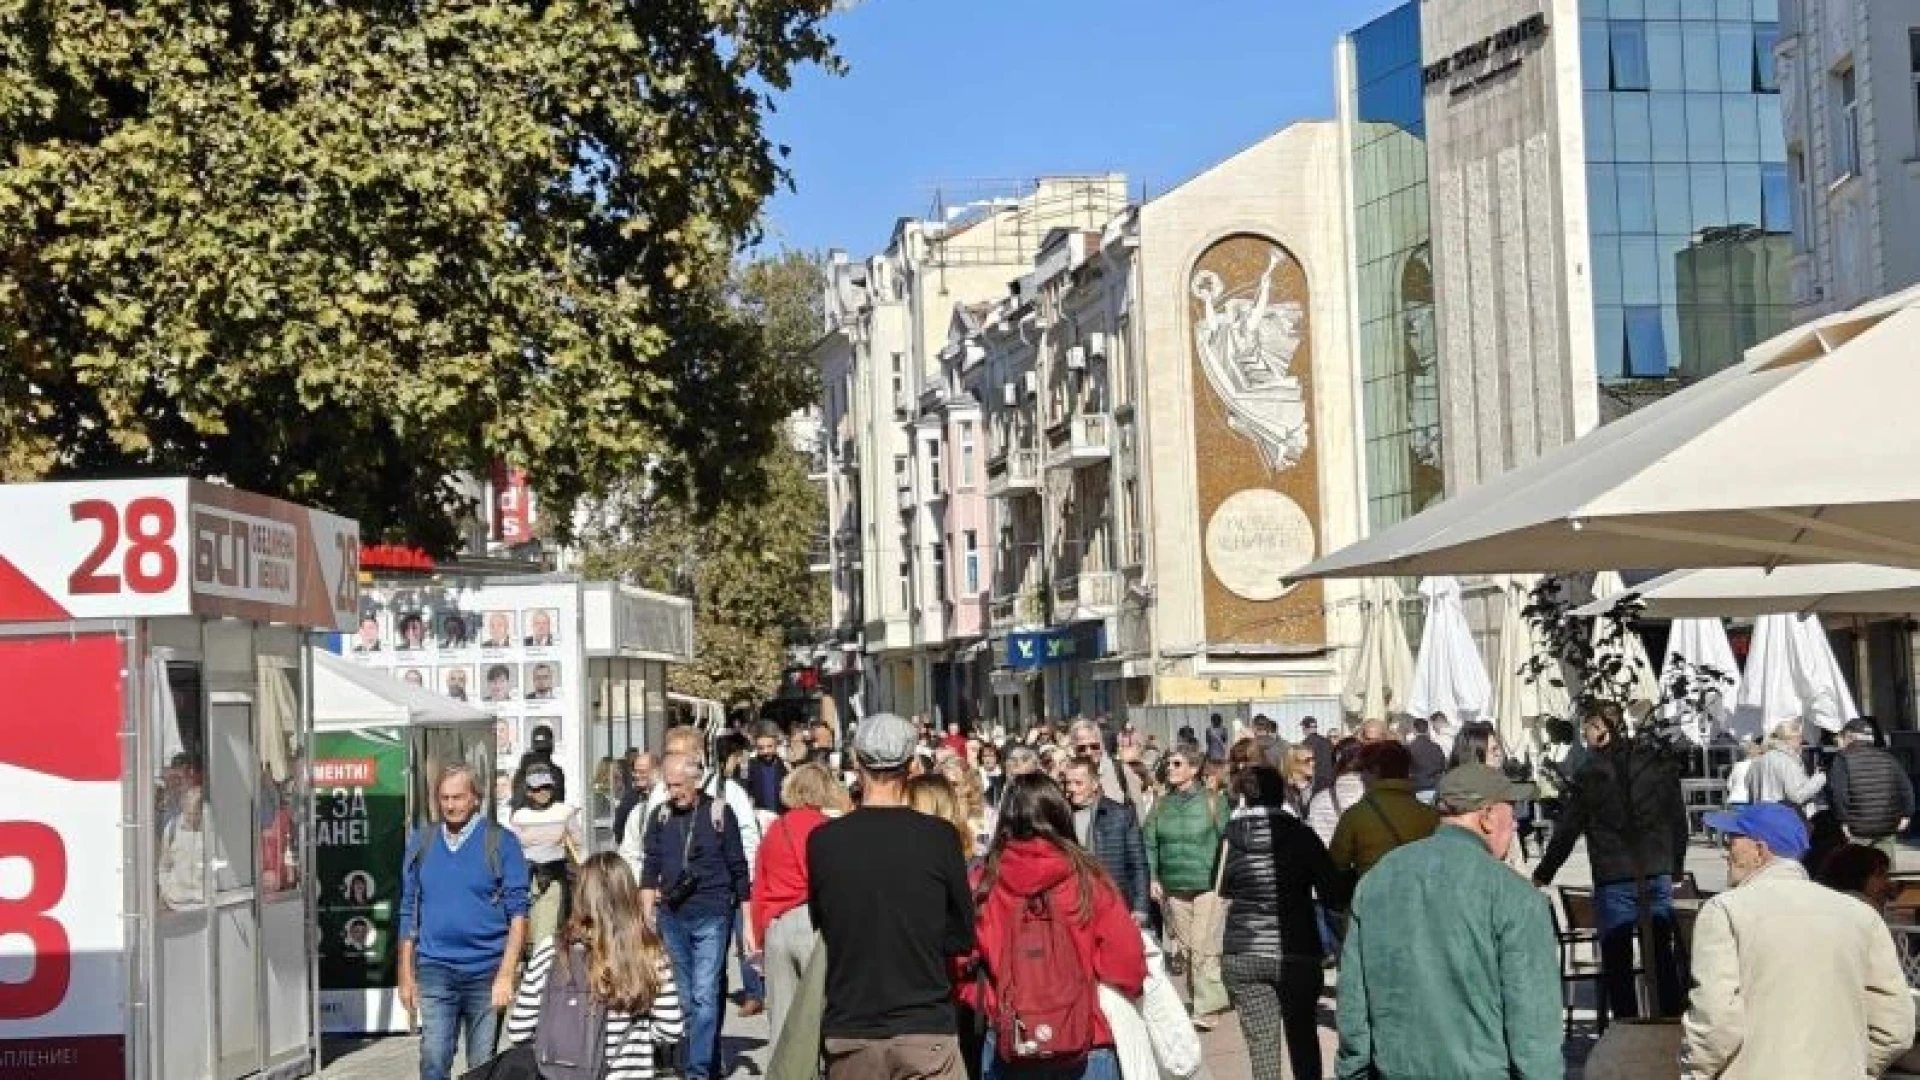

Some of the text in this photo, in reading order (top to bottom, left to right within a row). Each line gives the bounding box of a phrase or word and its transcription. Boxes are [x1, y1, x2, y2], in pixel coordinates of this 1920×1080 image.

[68, 497, 178, 596] 28
[194, 511, 251, 588] БСП
[332, 786, 367, 817] ЗА
